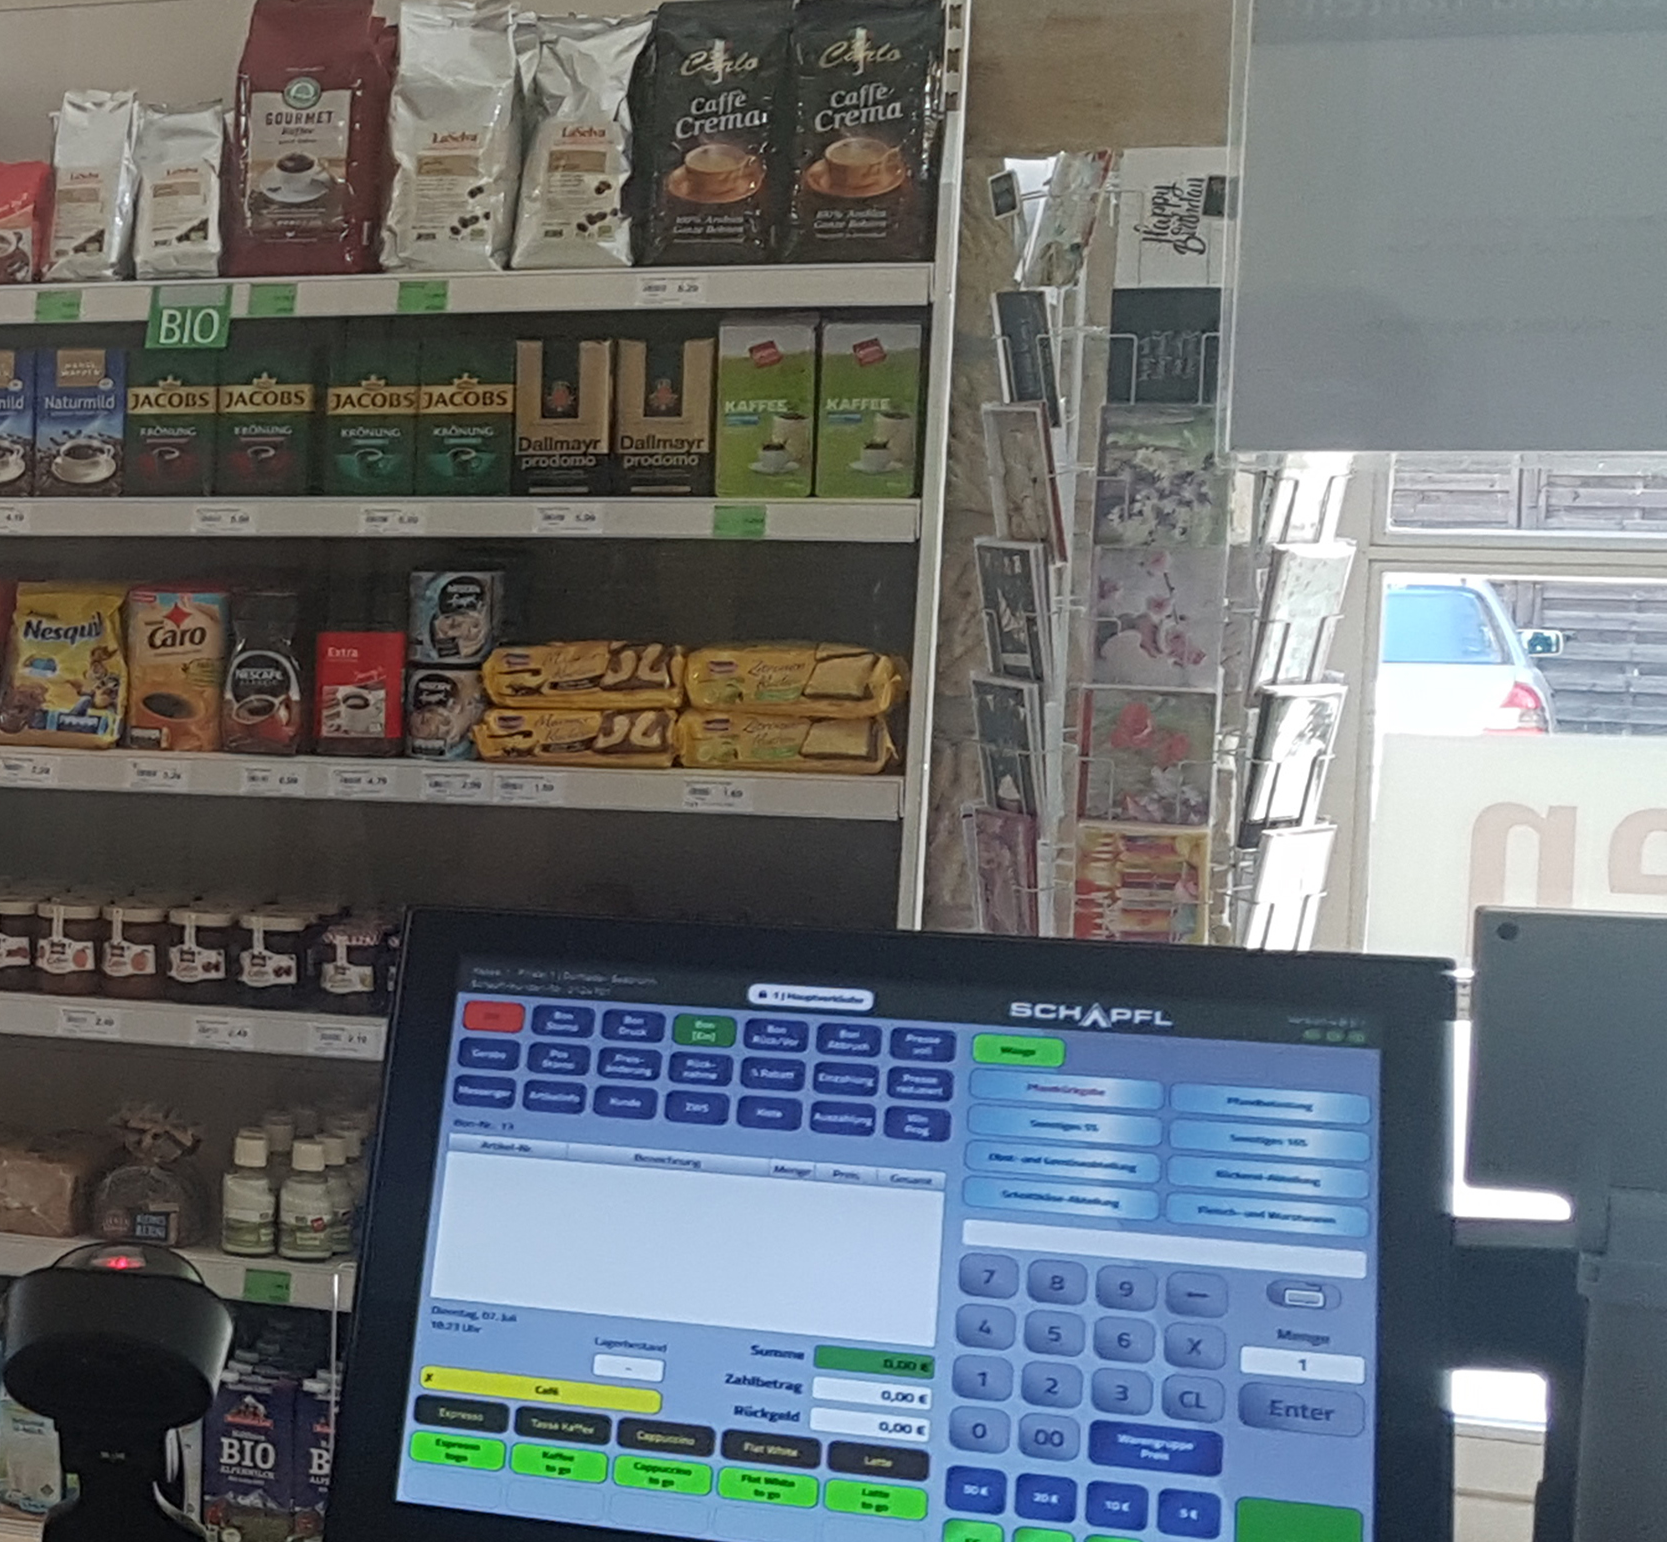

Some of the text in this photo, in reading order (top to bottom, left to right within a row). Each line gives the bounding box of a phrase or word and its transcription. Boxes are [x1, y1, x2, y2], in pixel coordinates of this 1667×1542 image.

[265, 110, 335, 126] GOURMET
[675, 109, 762, 140] Crema
[813, 100, 905, 133] Crema
[158, 308, 219, 345] BIO
[44, 394, 116, 411] Naturmild
[130, 392, 210, 412] JACOBS
[223, 389, 307, 409] JACOBS
[331, 391, 417, 412] JACOBS
[419, 388, 509, 411] JACOBS
[724, 399, 789, 413] KAFFEE
[825, 397, 891, 412] KAFFEE
[518, 435, 602, 457] Dallmayr
[619, 434, 705, 456] Dallmayr
[521, 453, 598, 471] prodomo
[623, 452, 700, 470] prodomo
[147, 623, 208, 650] Caro
[327, 646, 359, 659] Extra
[983, 1268, 996, 1285] 7
[1050, 1275, 1065, 1291] 8
[1119, 1280, 1134, 1298] 9
[978, 1319, 992, 1335] 4
[1047, 1326, 1062, 1343] 5
[594, 1336, 668, 1353] Lagerbestand
[1116, 1332, 1132, 1350] 6
[1186, 1337, 1204, 1356] X
[750, 1344, 931, 1374] Summe 0,00 €
[1297, 1358, 1308, 1372] 1
[977, 1371, 987, 1387] 1
[1045, 1377, 1059, 1396] 2
[724, 1373, 929, 1405] Zahlbetrag 0,00 €
[1115, 1384, 1129, 1402] 3
[1178, 1390, 1207, 1410] CL
[1268, 1398, 1335, 1422] Enter
[733, 1404, 927, 1437] Rückgeld 0,00 €
[635, 1430, 696, 1447] Cappuccino
[971, 1422, 988, 1439] 0
[1033, 1428, 1065, 1448] 00
[220, 1436, 276, 1470] BIO
[633, 1461, 693, 1478] Cappuccino
